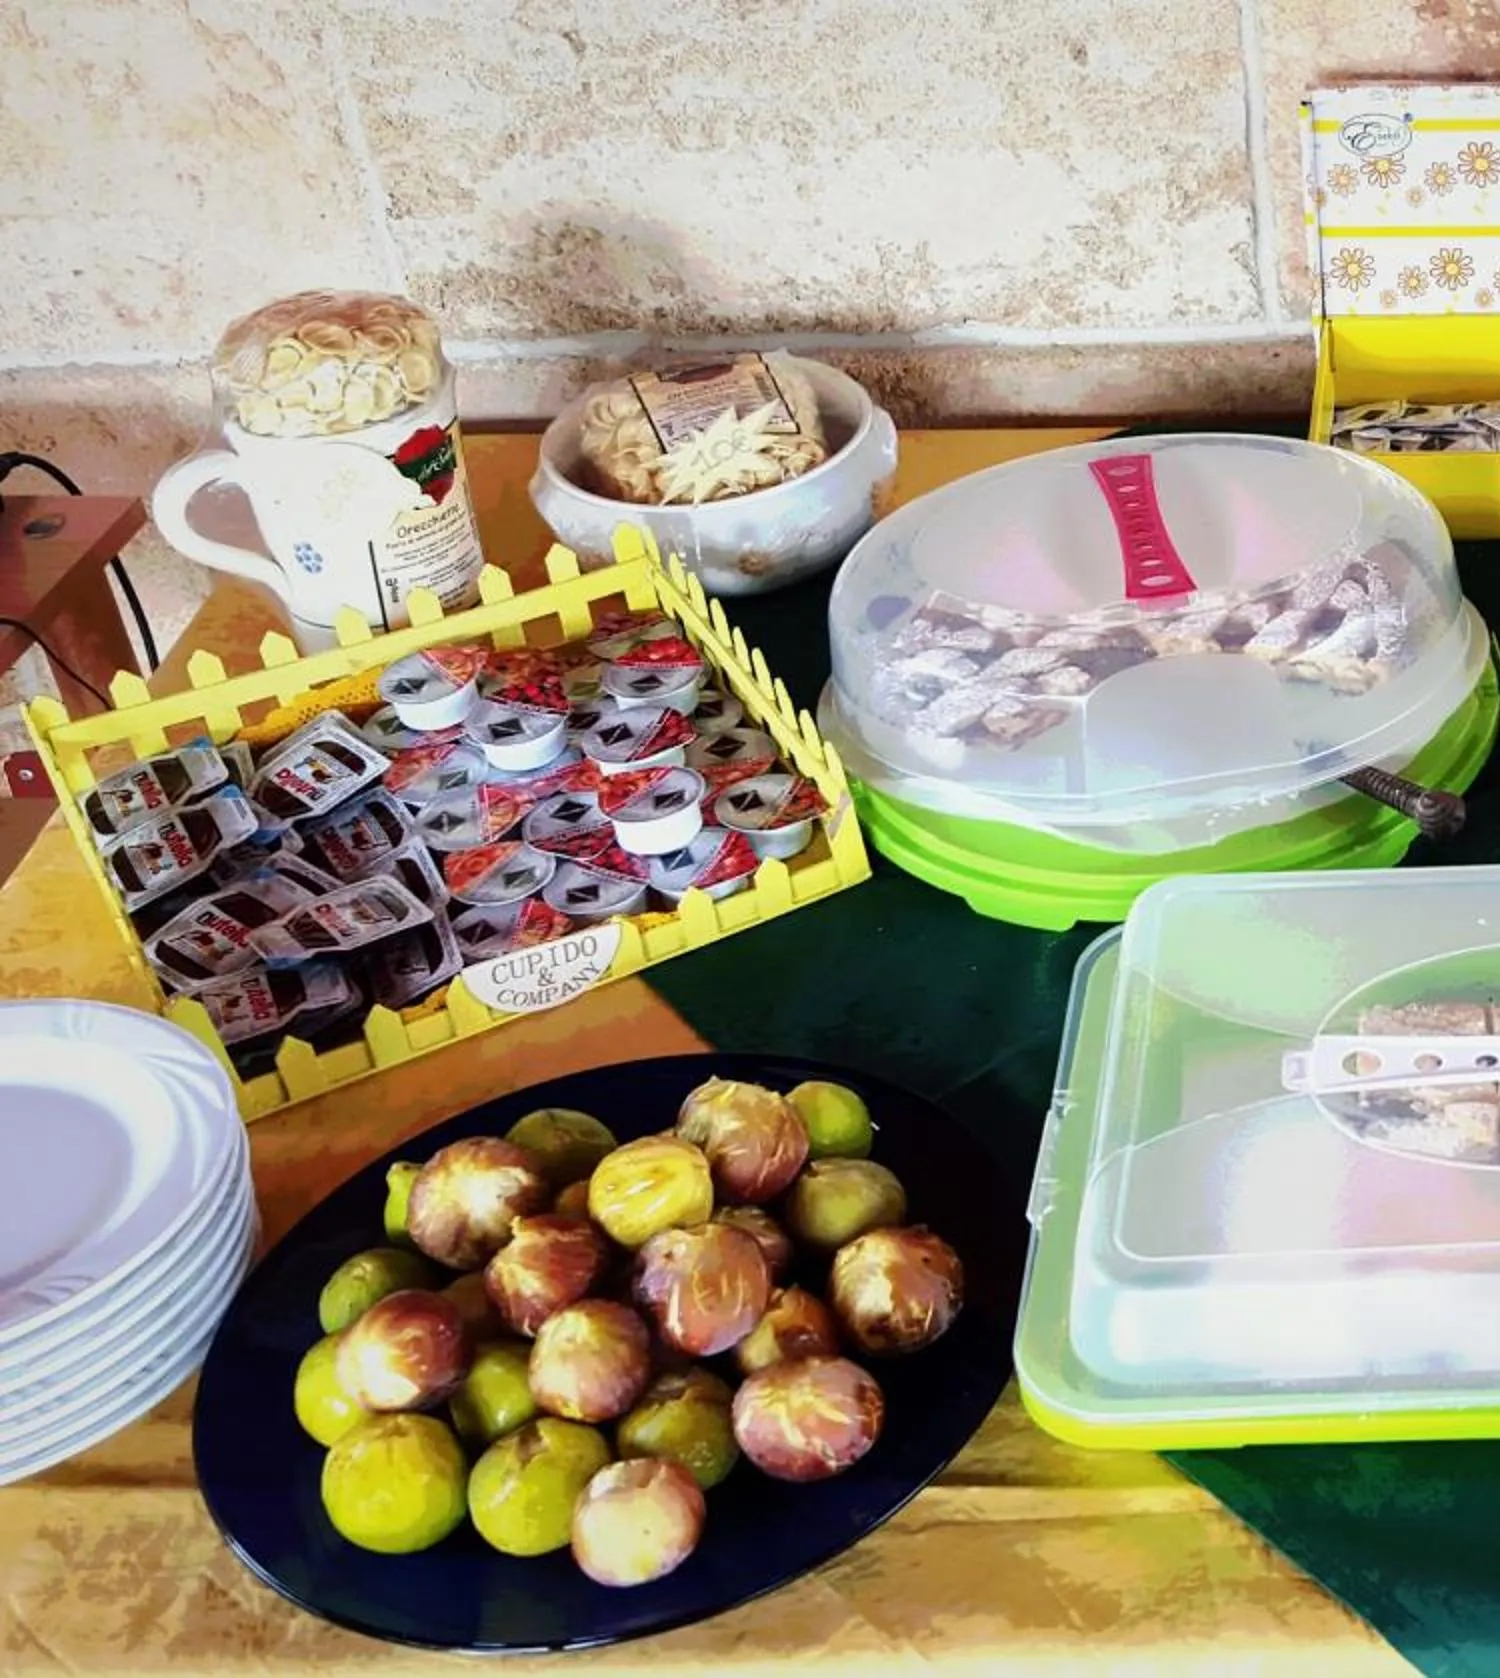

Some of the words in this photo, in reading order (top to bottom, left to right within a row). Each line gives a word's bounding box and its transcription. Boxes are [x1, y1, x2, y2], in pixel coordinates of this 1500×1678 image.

[491, 935, 598, 985] CUPIDO
[537, 965, 556, 987] &
[496, 961, 601, 1008] COMPANY
